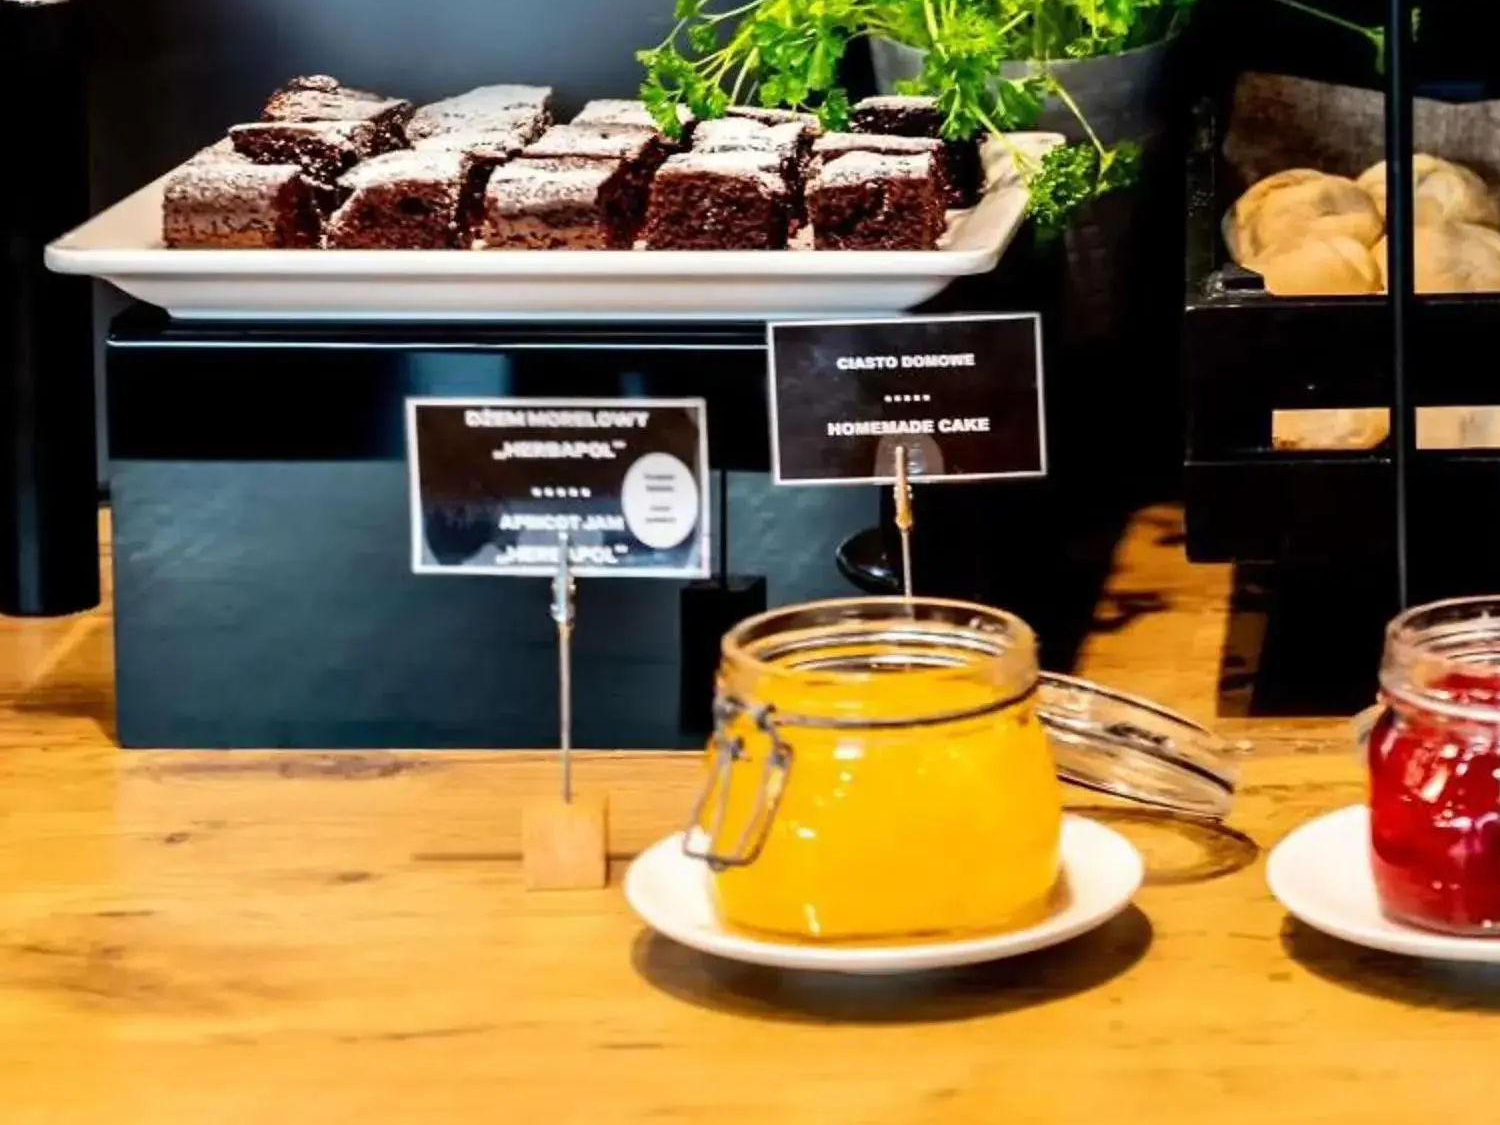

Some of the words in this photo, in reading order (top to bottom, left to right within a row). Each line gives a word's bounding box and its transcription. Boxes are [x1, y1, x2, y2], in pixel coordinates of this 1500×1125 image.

[837, 355, 898, 370] CIASTO
[901, 353, 976, 368] DOMOWE
[827, 419, 935, 436] HOMEMADE
[938, 417, 990, 433] CAKE
[582, 514, 625, 531] JAM
